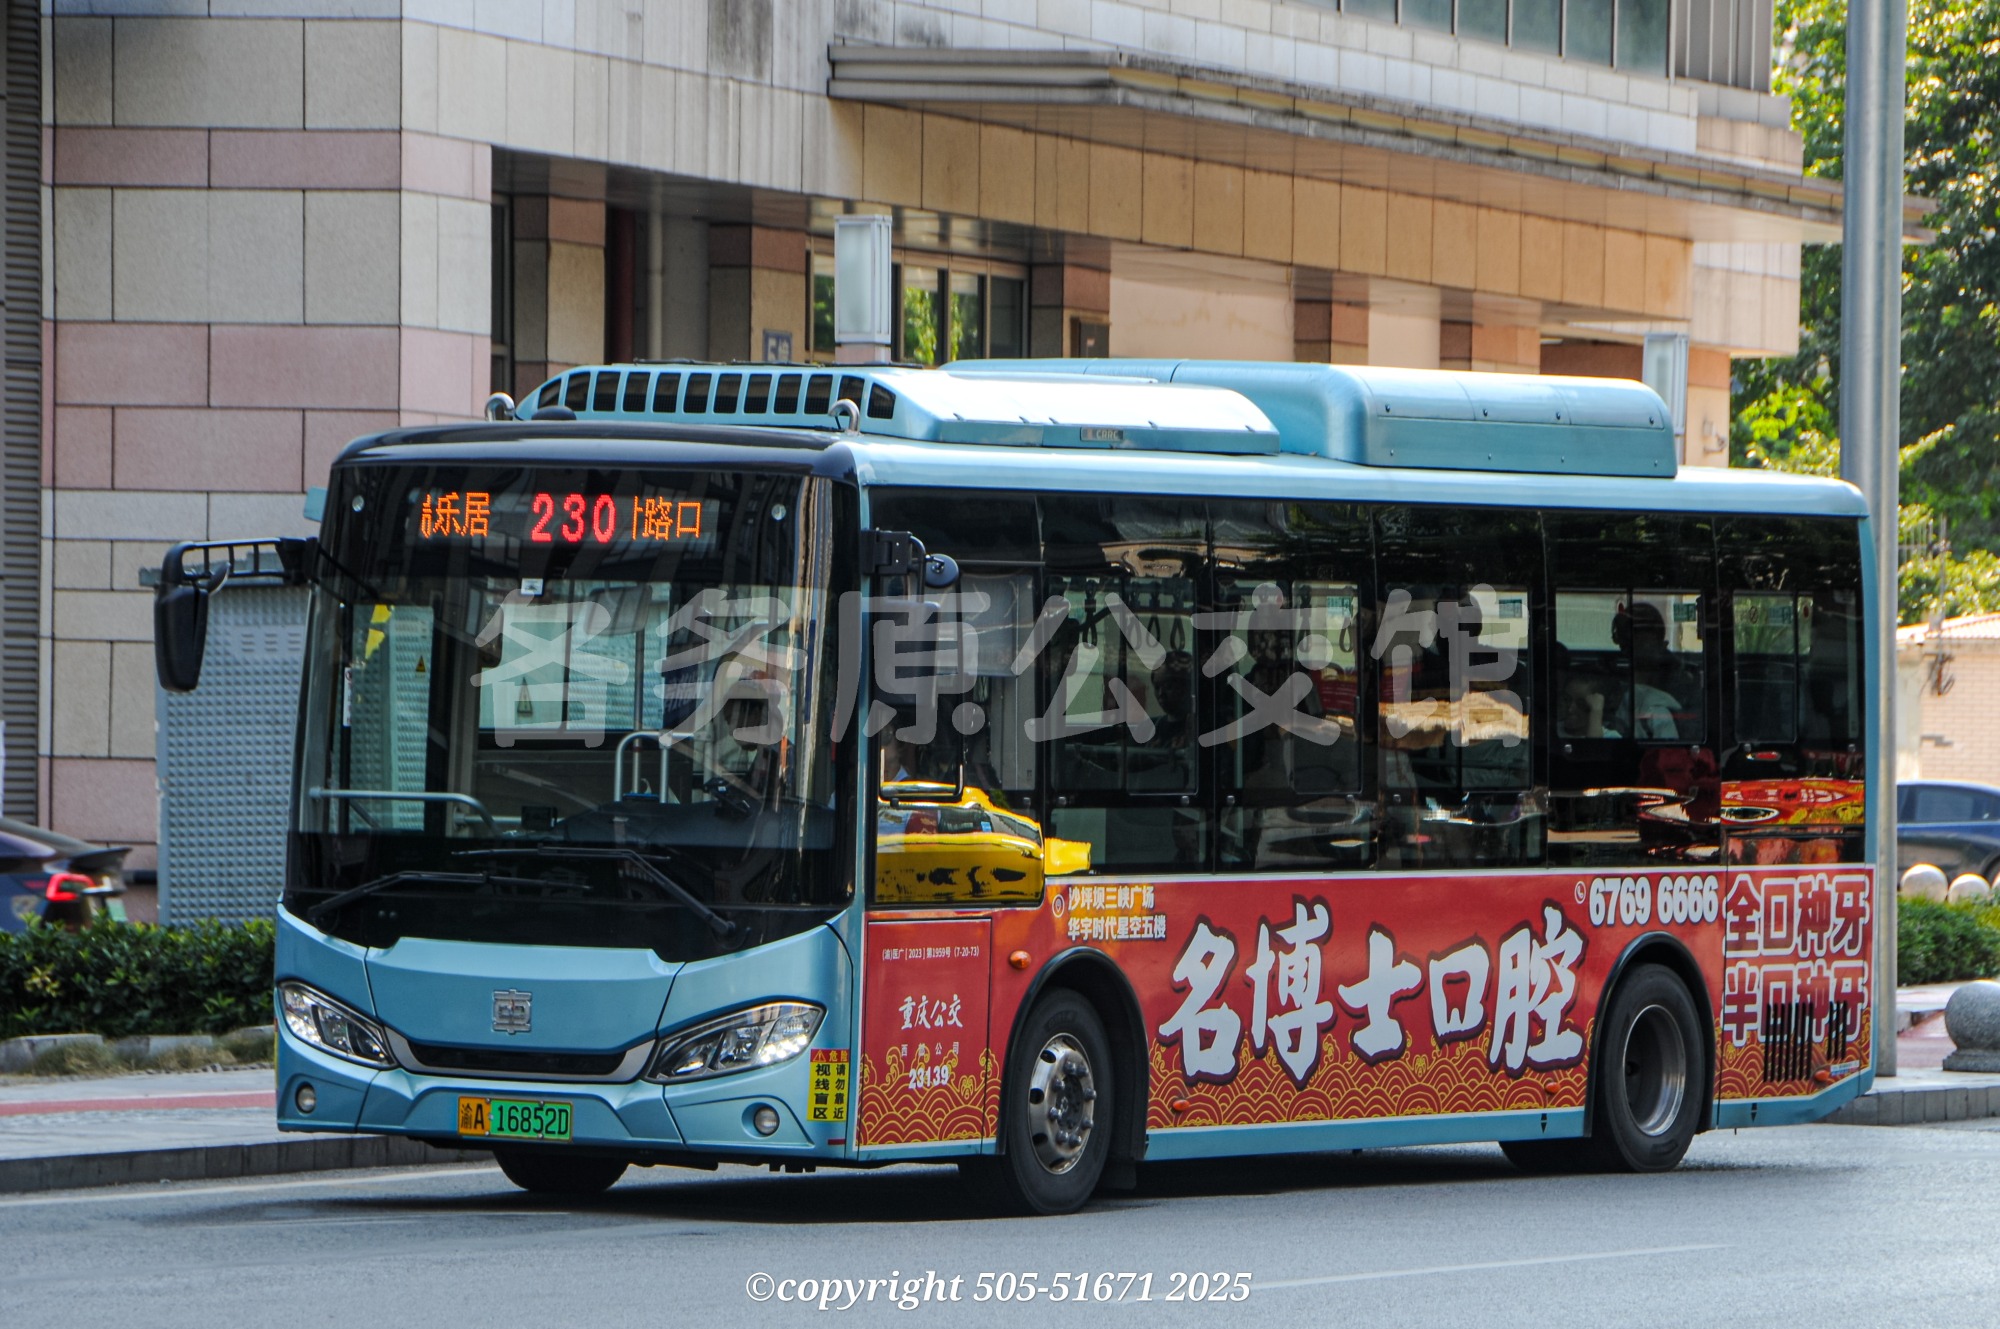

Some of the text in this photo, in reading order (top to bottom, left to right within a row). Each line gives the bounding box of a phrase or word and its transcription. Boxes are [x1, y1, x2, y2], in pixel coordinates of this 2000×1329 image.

[531, 493, 617, 542] 230
[1068, 885, 1155, 911] 沙坪坝三峡广场
[1589, 874, 1720, 926] 6769 6666
[1722, 873, 1869, 957] 全口种牙
[1067, 915, 1166, 941] 华宇时代星空五楼
[898, 993, 963, 1030] 重庆公交
[1158, 902, 1584, 1081] 名博士口腔
[1722, 958, 1868, 1047] 半口种牙
[829, 1050, 848, 1062] 危险
[901, 1041, 960, 1057] 西部公司
[813, 1063, 831, 1120] 视线盲区
[833, 1063, 846, 1120] 请勿靠近
[908, 1065, 951, 1090] 23139
[460, 1102, 569, 1136] 渝A 16852D
